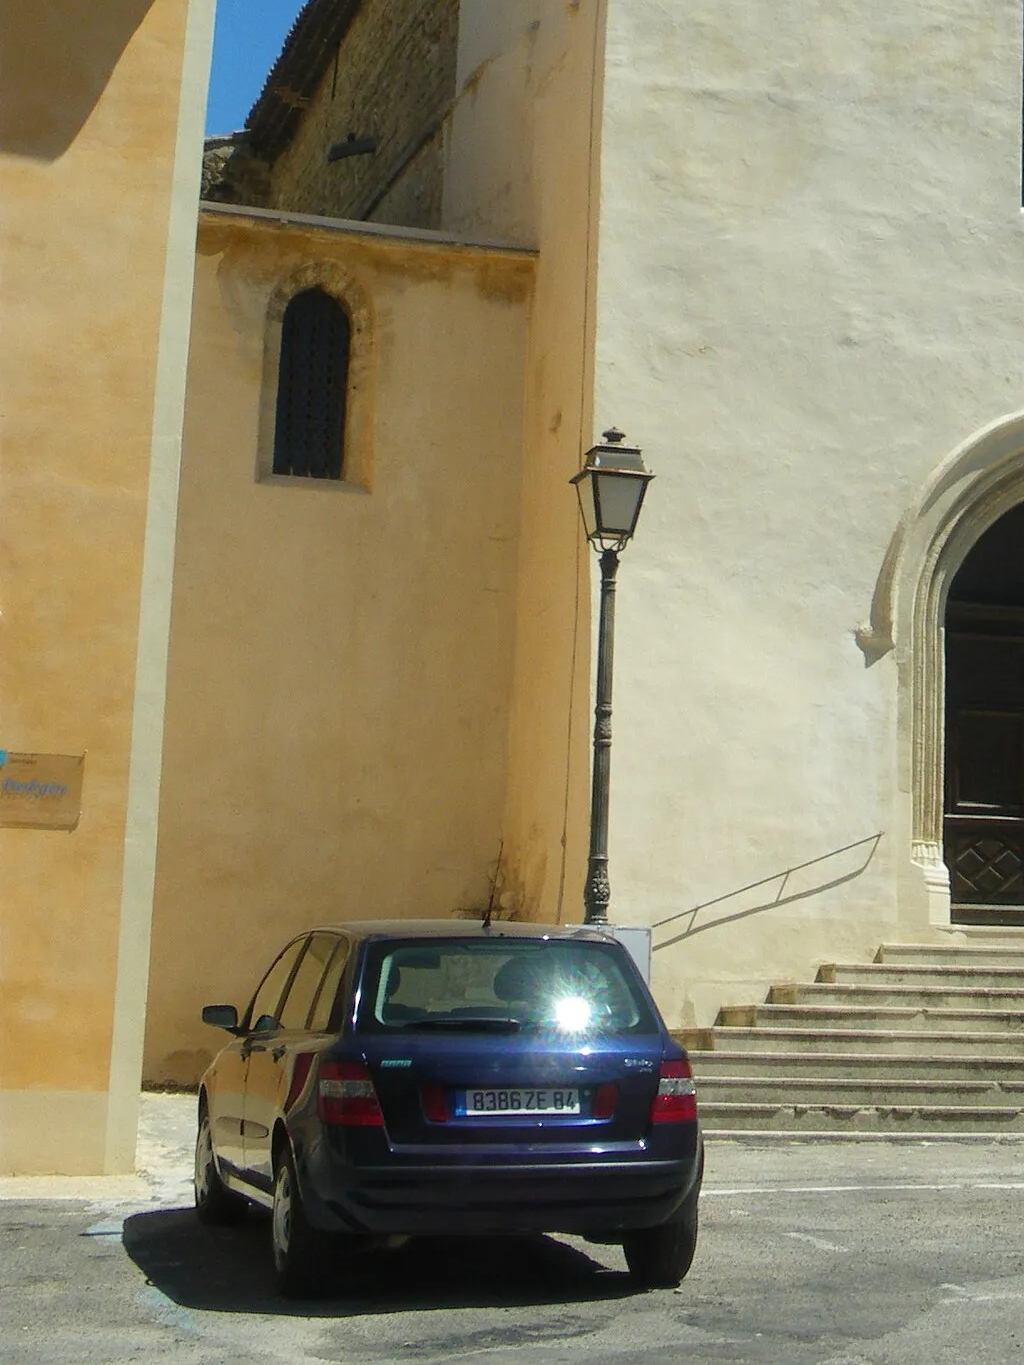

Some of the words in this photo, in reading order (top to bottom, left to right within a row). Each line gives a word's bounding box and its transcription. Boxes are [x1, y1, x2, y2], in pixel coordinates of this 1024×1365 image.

[473, 1091, 521, 1110] 8386
[525, 1091, 547, 1110] ZE
[553, 1091, 576, 1110] 84
